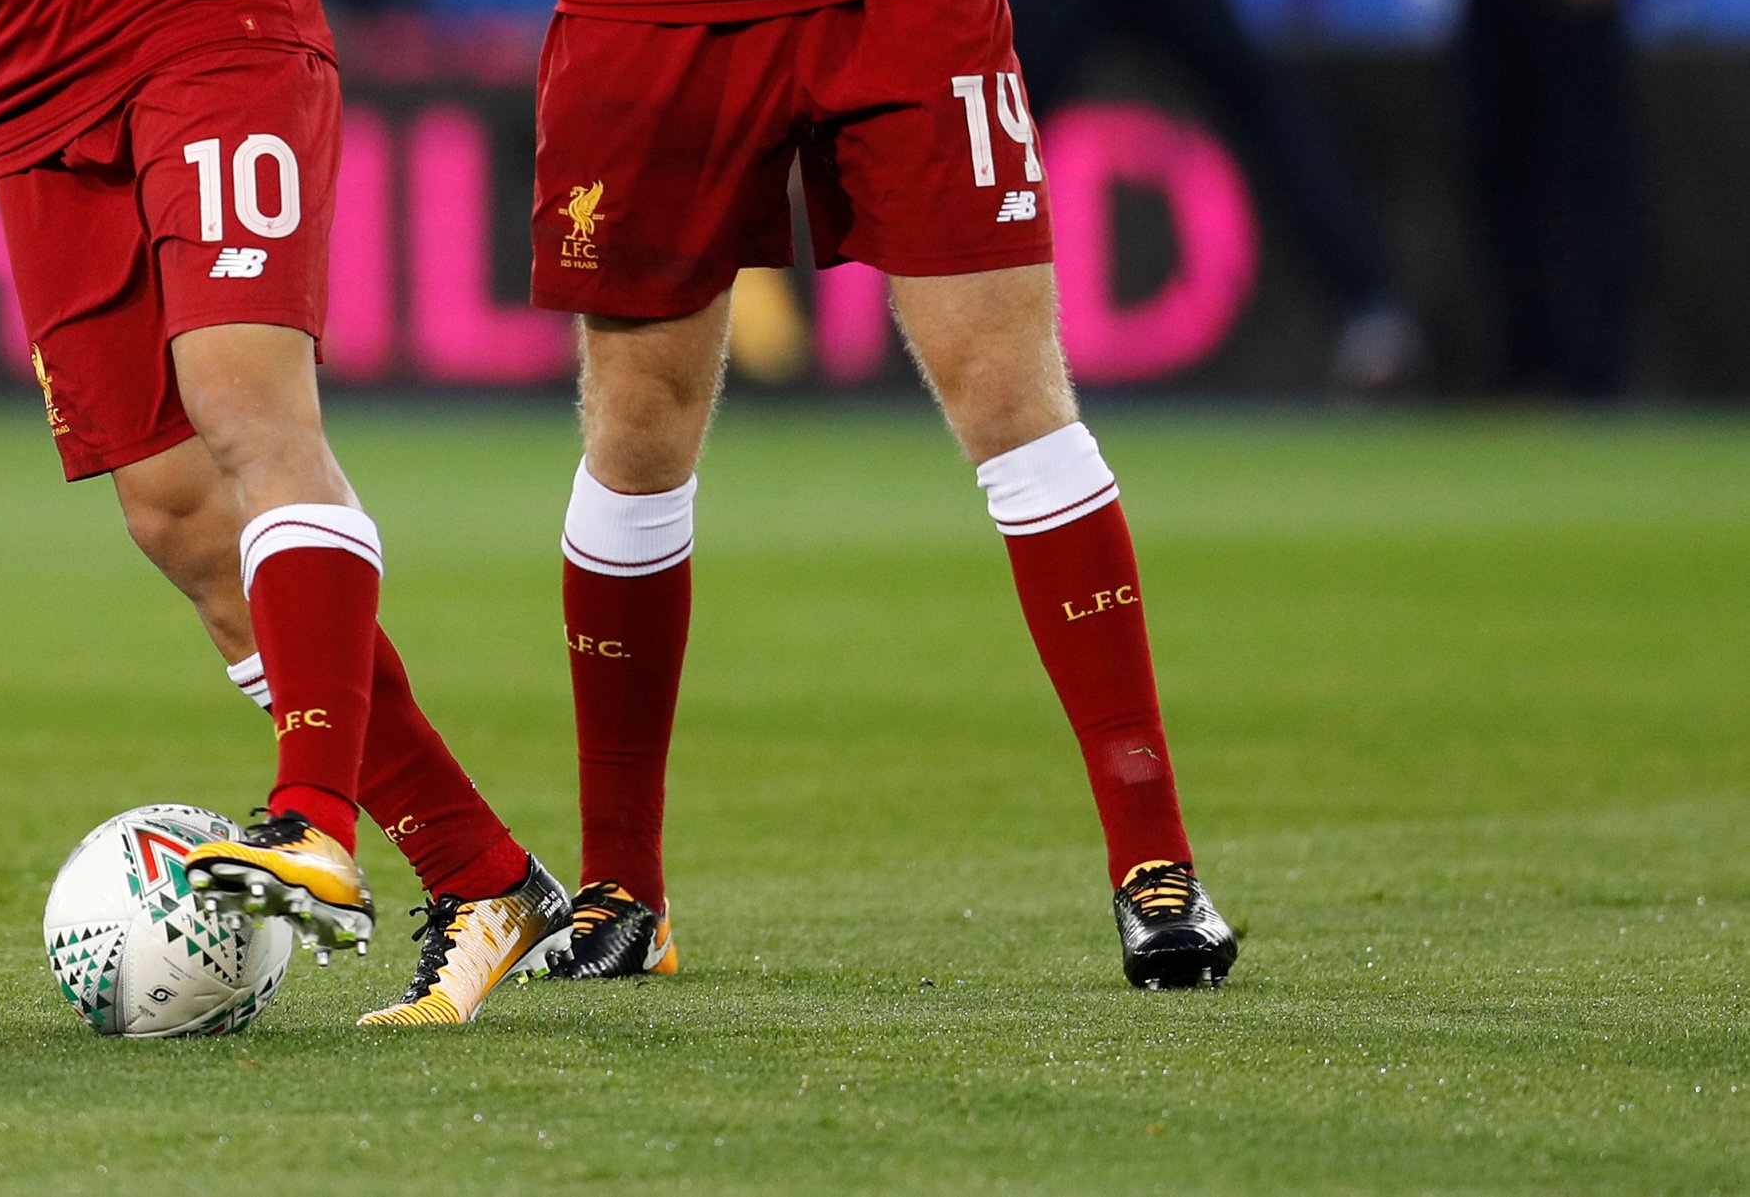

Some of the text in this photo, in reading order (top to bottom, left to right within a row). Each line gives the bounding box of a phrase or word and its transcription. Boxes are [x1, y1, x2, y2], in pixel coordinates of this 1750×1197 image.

[951, 72, 1043, 187] 14
[184, 134, 301, 242] 10
[1061, 584, 1139, 622] L.F.C.
